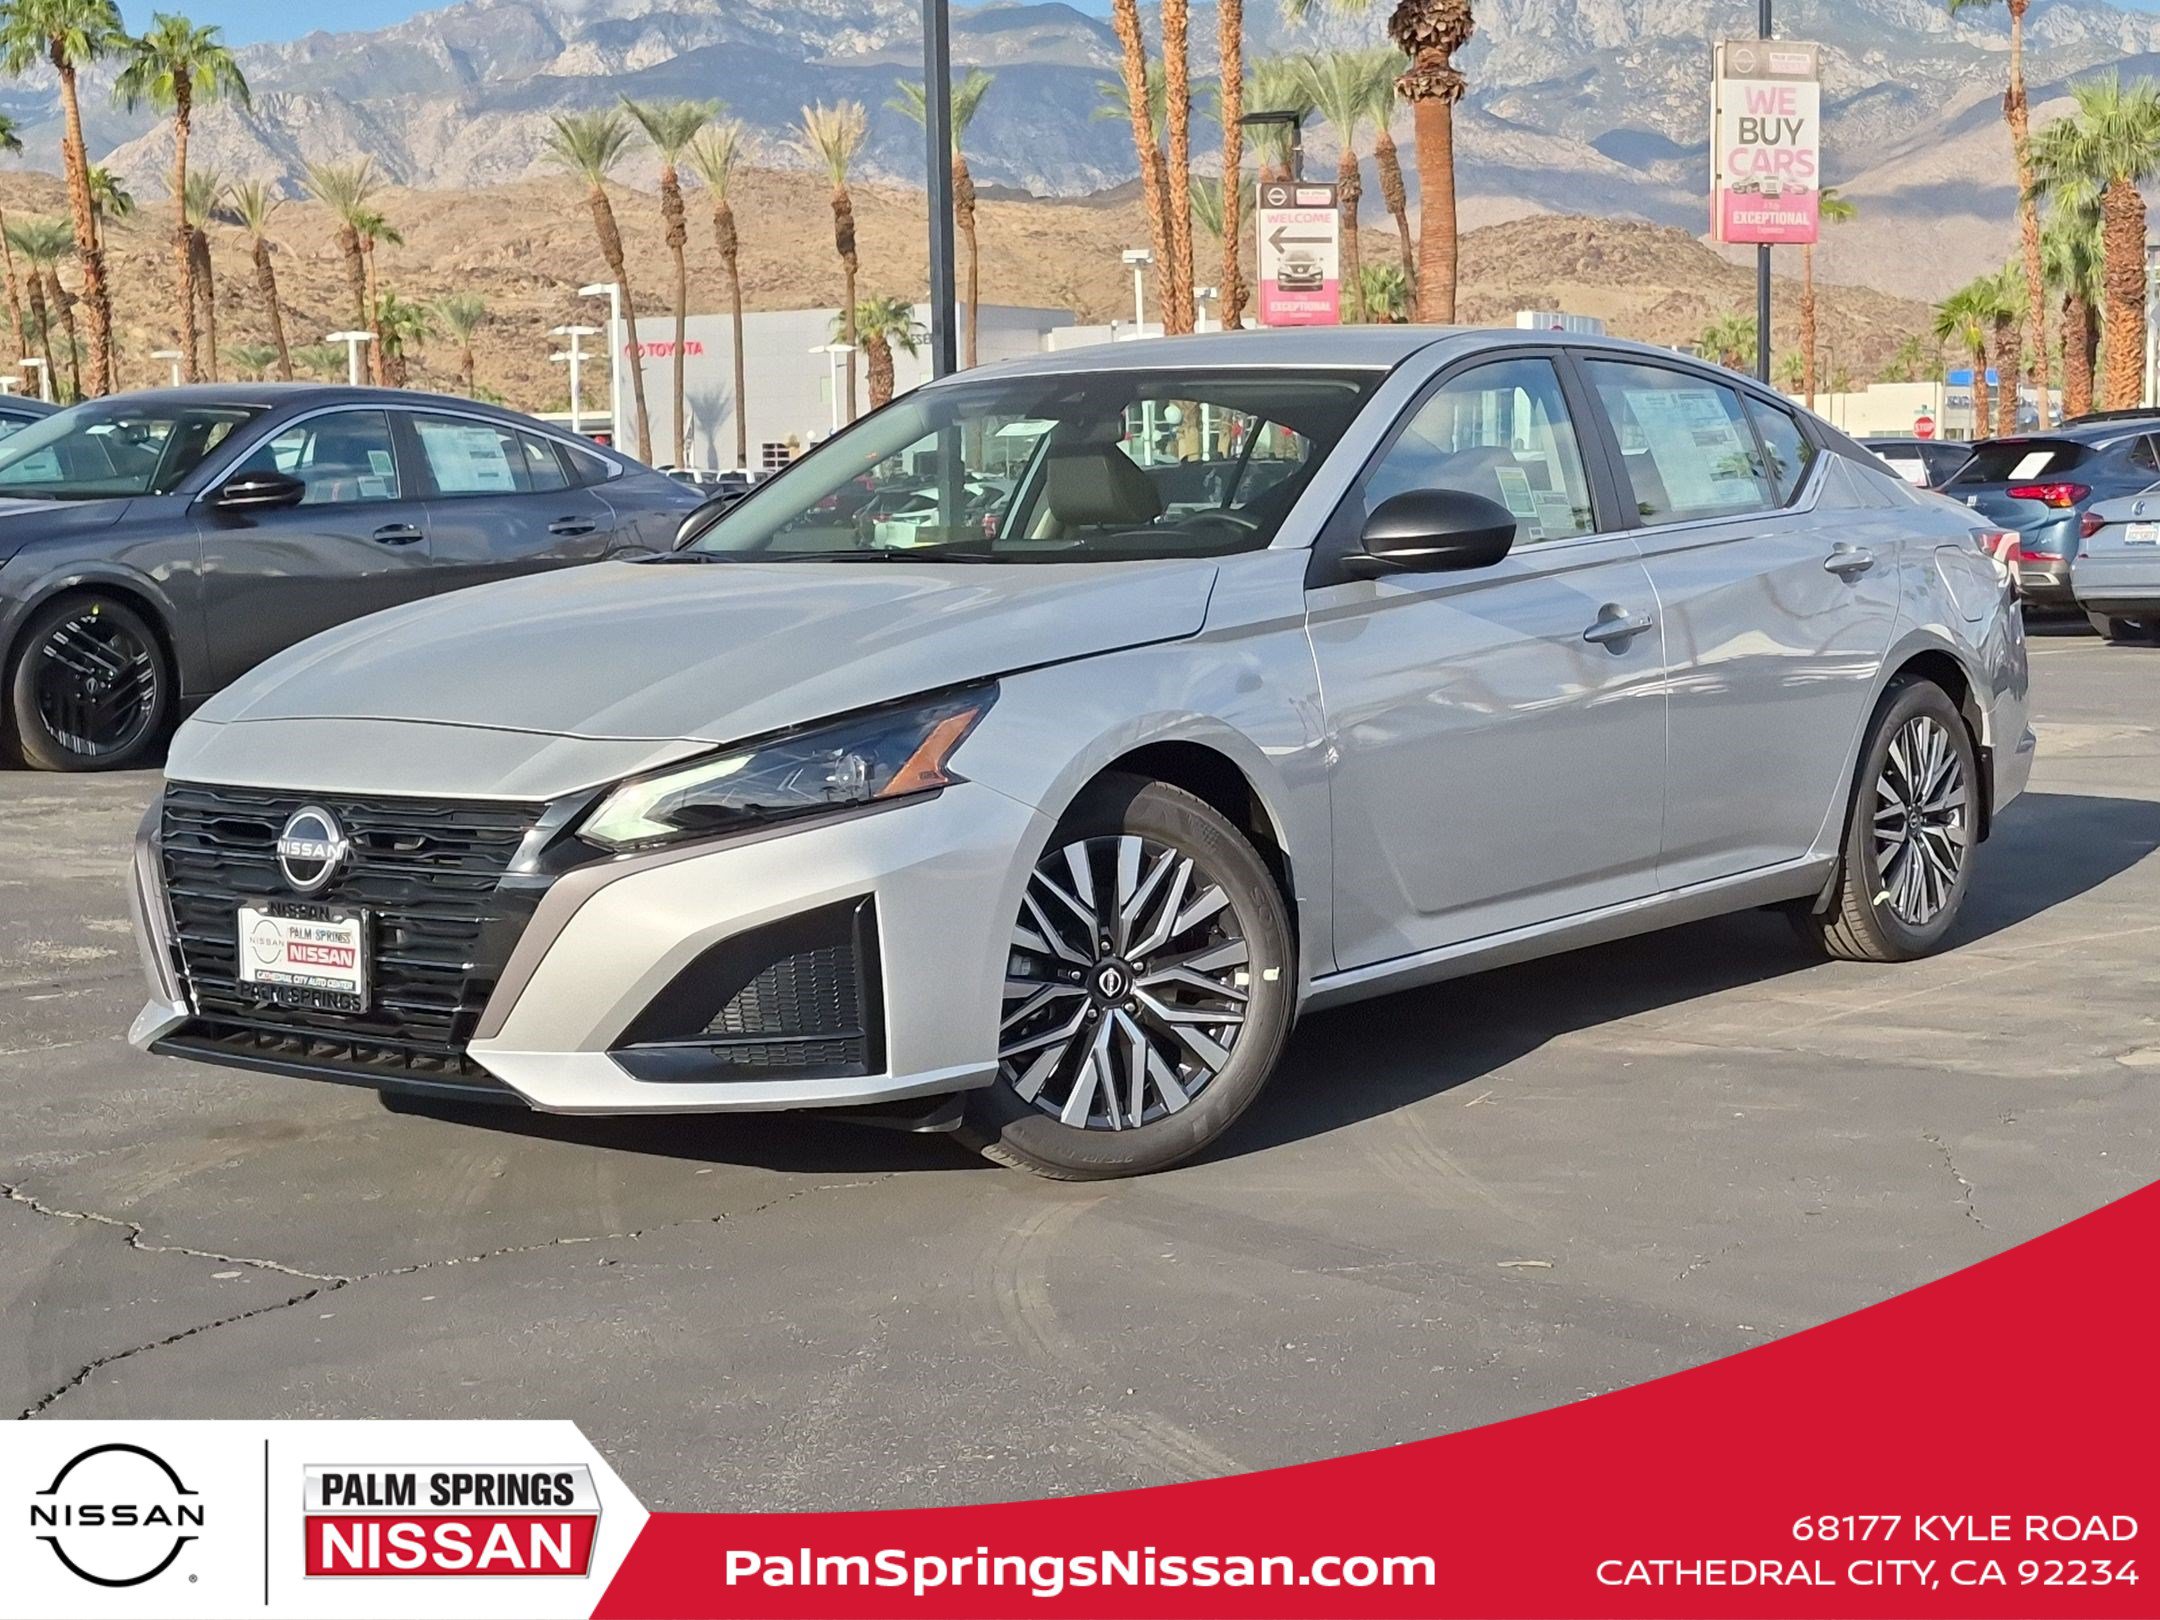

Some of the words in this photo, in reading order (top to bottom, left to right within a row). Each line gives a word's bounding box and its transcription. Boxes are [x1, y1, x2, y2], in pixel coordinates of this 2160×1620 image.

[1744, 87, 1797, 115] WE
[1738, 117, 1804, 145] BUY
[1728, 148, 1815, 177] CARS
[1267, 214, 1332, 223] WELCOME
[1733, 211, 1810, 225] EXCEPTIONAL
[1270, 301, 1331, 312] EXCEPTIONAL
[646, 342, 703, 356] TOYTA
[1915, 423, 1934, 432] STOP
[277, 839, 347, 860] NISSAN
[269, 901, 330, 919] NISSAN
[249, 936, 285, 947] NISSAN
[289, 926, 312, 940] PALM
[315, 930, 352, 944] SPRINGS
[289, 944, 353, 967] NISSAN
[293, 975, 308, 985] CITY
[308, 977, 327, 987] AUTO
[240, 982, 288, 1001] PALM
[289, 986, 361, 1011] SPRINGS
